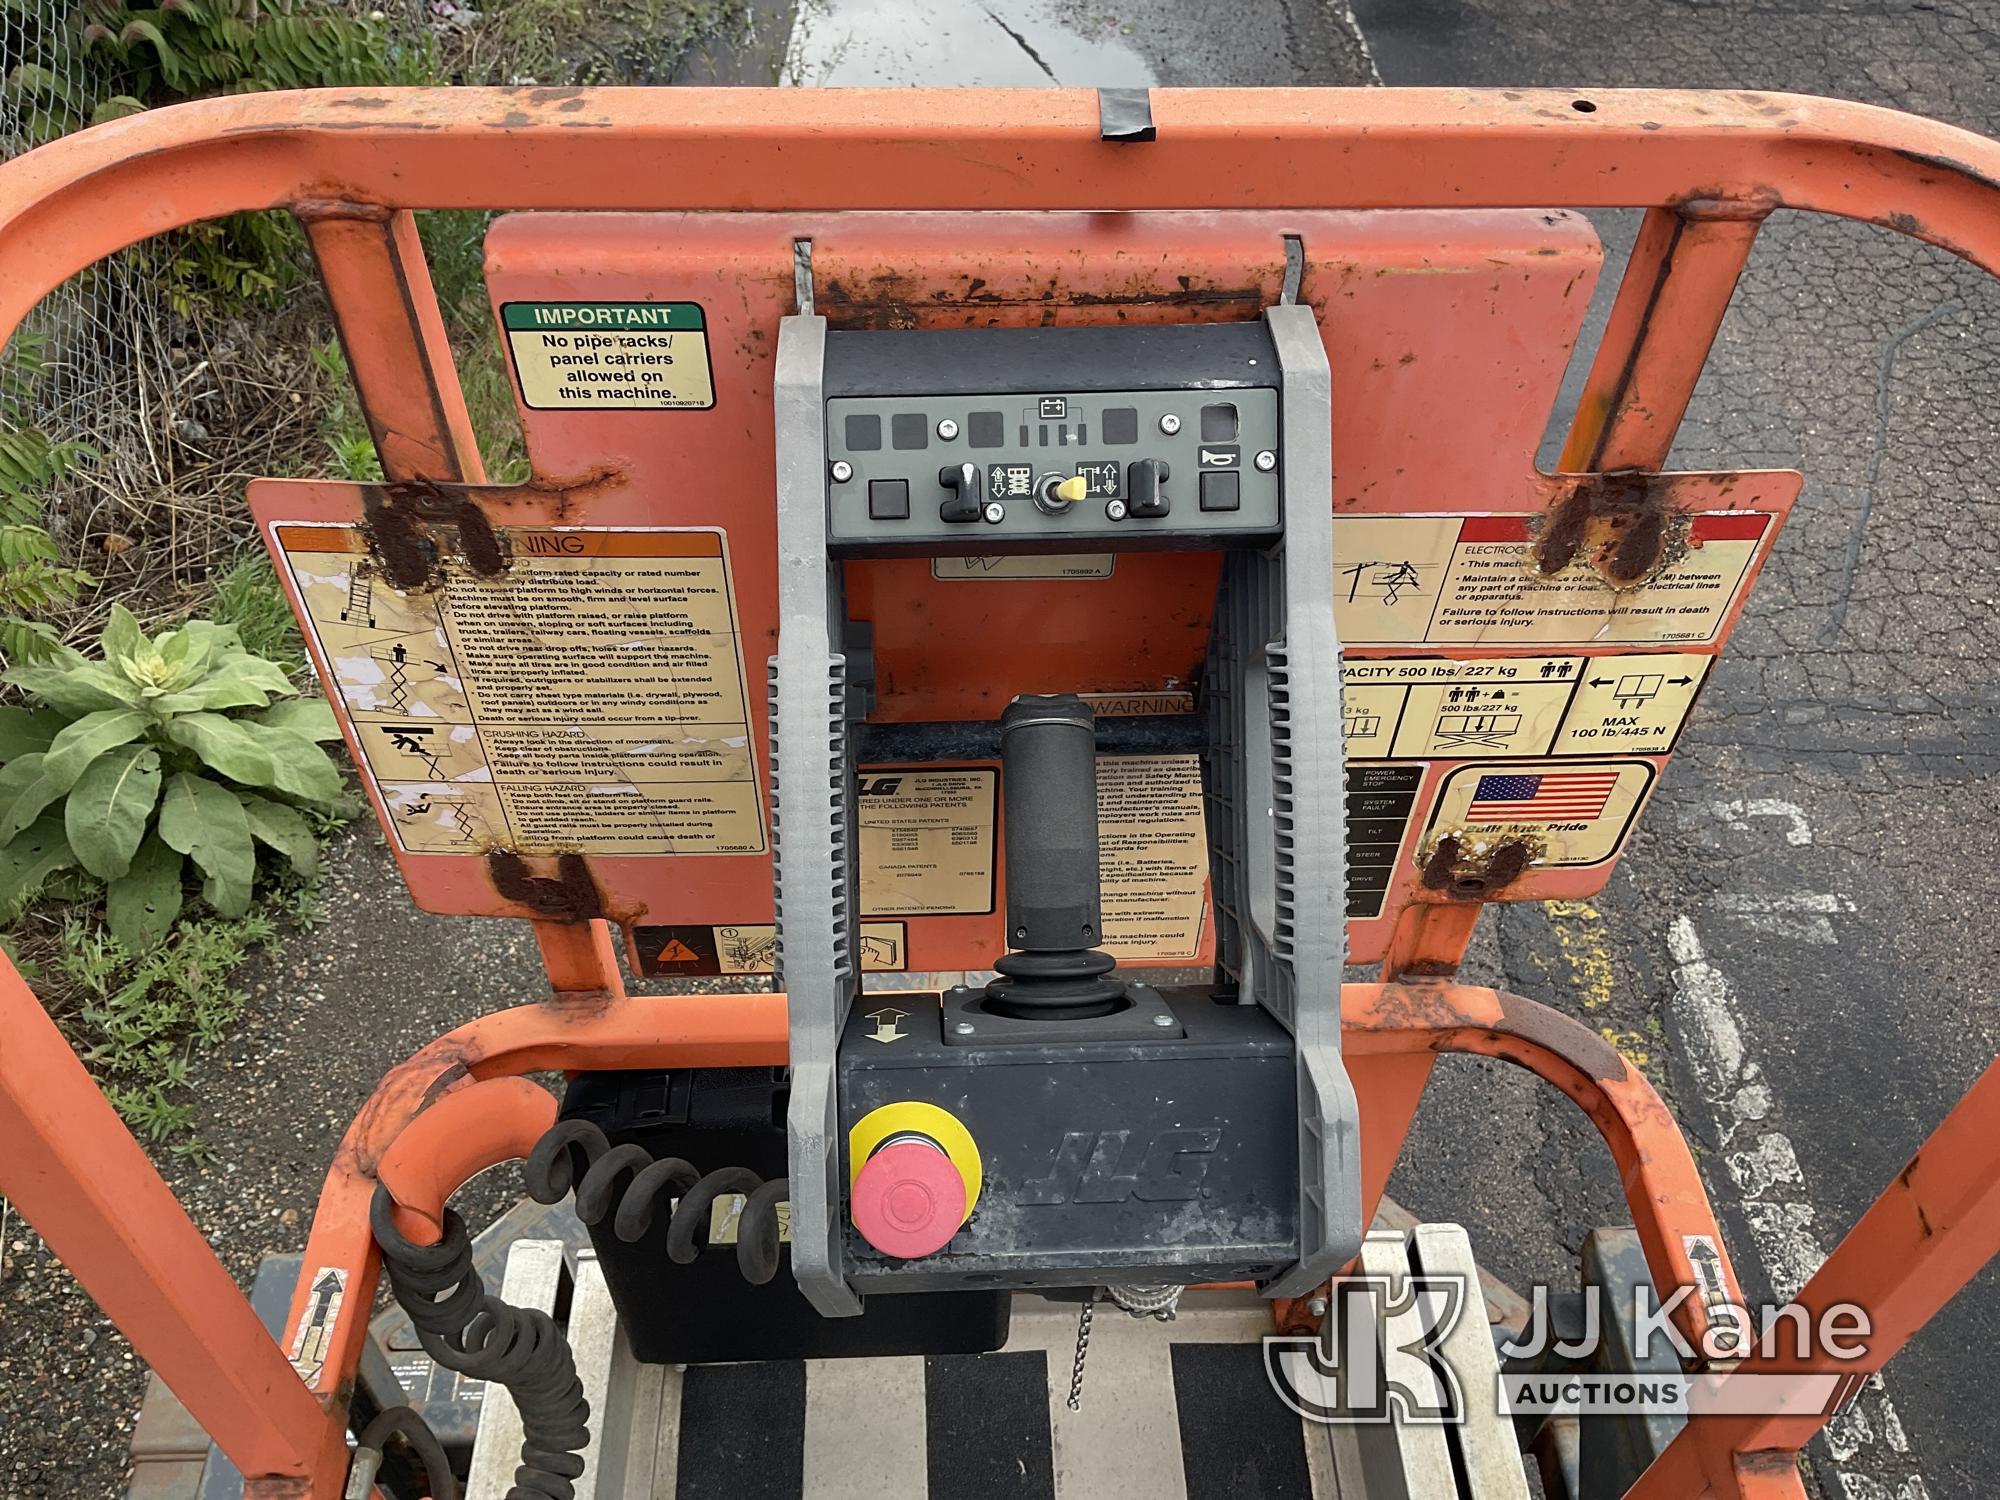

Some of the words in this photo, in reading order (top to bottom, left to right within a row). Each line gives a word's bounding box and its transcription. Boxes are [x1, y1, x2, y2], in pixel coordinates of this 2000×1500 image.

[534, 308, 671, 324] IMPORTANT
[542, 335, 568, 347] No
[574, 335, 612, 350] pipe
[620, 335, 673, 348] racks/
[550, 353, 598, 367] panel
[604, 353, 673, 364] carriers
[567, 370, 635, 382] allowed
[641, 372, 662, 382] on
[559, 387, 592, 398] this
[597, 387, 677, 398] machine.
[1537, 608, 1605, 616] instructions
[1500, 618, 1534, 627] injury.
[1400, 668, 1427, 677] 500
[1431, 667, 1462, 677] lbs/
[1464, 667, 1494, 676] 227
[1498, 667, 1518, 677] kg
[1602, 717, 1640, 726] MAX
[1571, 729, 1598, 737] 100
[1602, 727, 1650, 737] lb/445
[1653, 726, 1666, 735] N
[1465, 825, 1502, 833] Built
[1546, 823, 1588, 831] Pride
[1015, 1128, 1222, 1206] JLG
